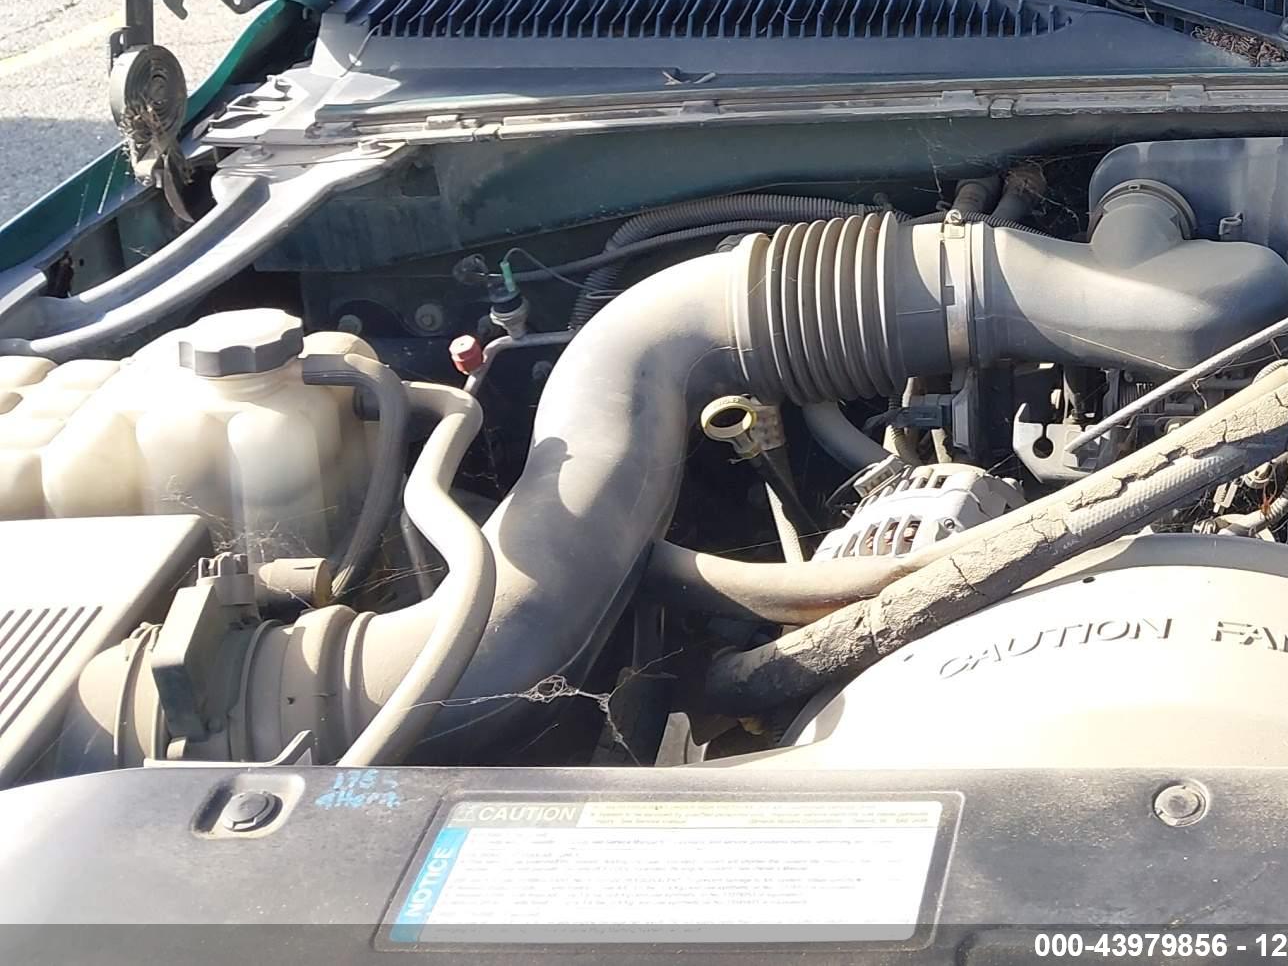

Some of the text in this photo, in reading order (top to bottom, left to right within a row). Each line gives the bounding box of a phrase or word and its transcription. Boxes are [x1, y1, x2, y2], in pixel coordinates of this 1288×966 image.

[938, 617, 1173, 679] CAUTION
[479, 807, 577, 821] CAUTION
[403, 847, 453, 918] NOTICE
